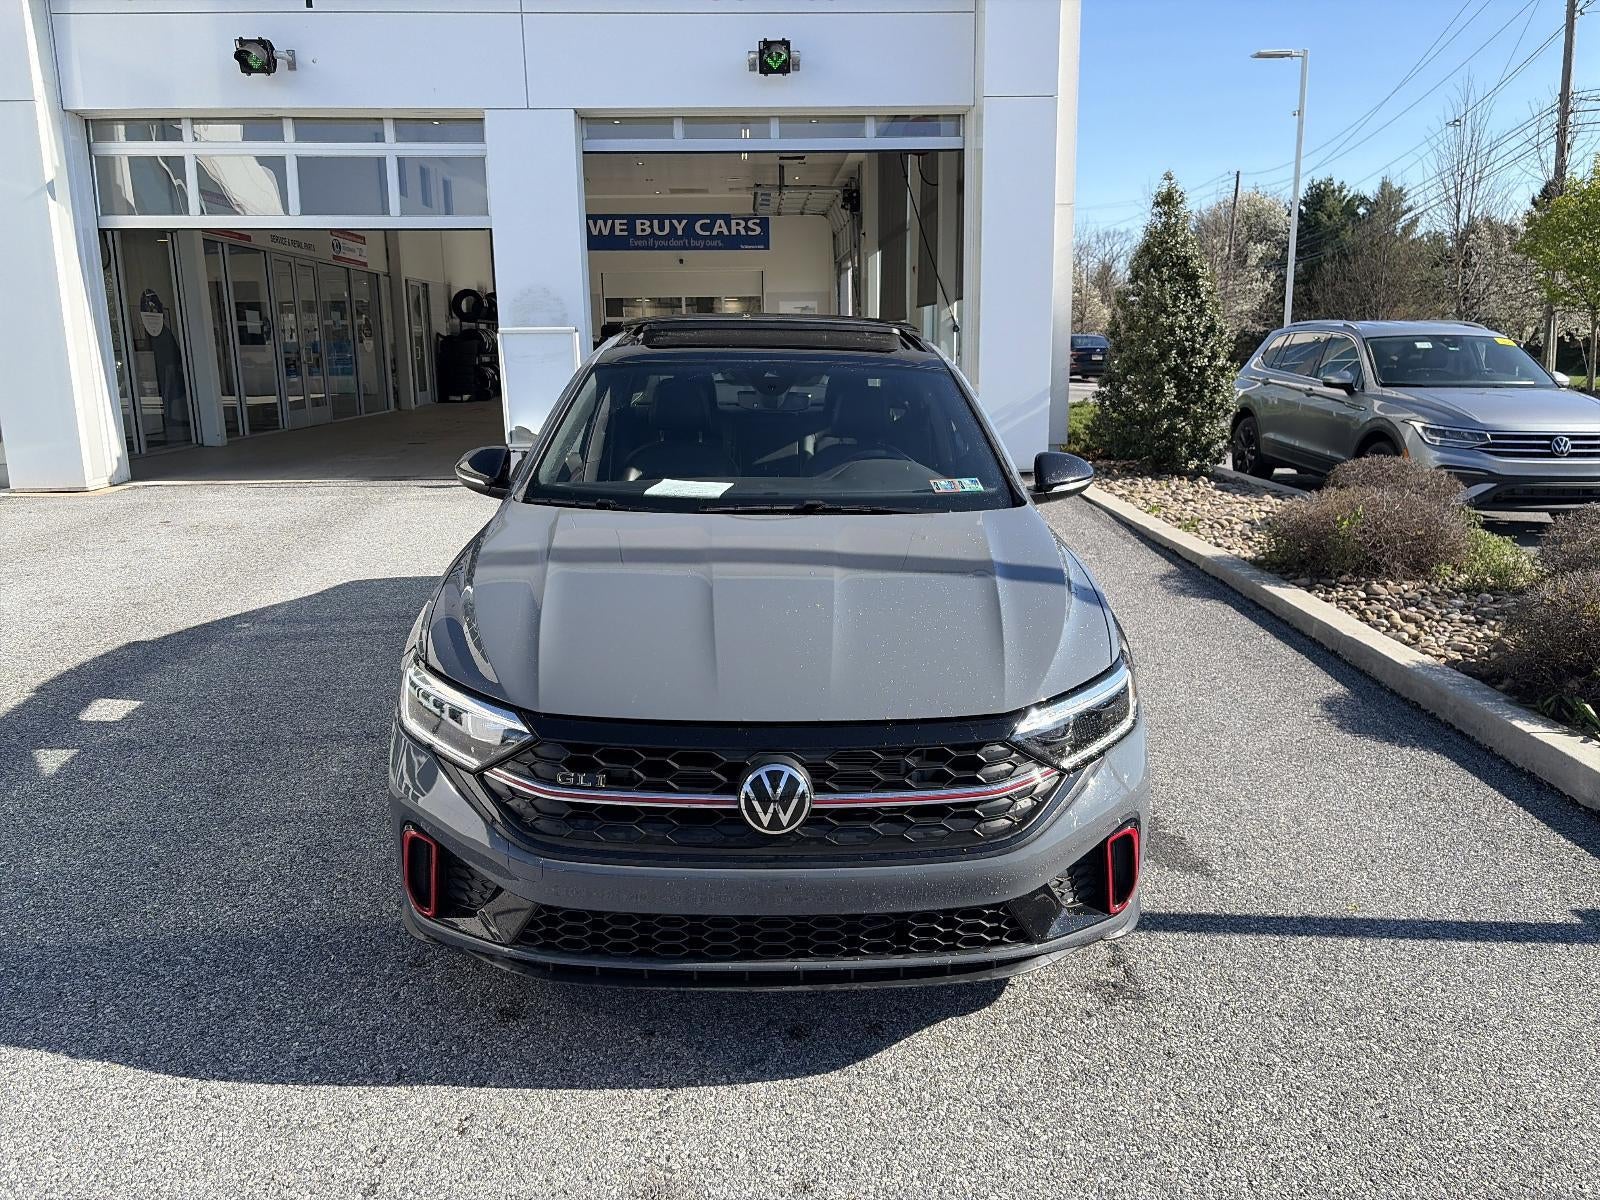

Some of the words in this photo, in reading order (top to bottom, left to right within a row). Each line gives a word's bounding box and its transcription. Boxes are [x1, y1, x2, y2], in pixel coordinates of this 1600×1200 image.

[587, 219, 628, 236] WE
[635, 219, 689, 236] BUY
[629, 238, 648, 247] Even
[648, 238, 654, 247] if
[654, 239, 669, 249] you
[669, 238, 689, 247] don't
[690, 238, 705, 249] buy
[556, 771, 607, 788] GLI
